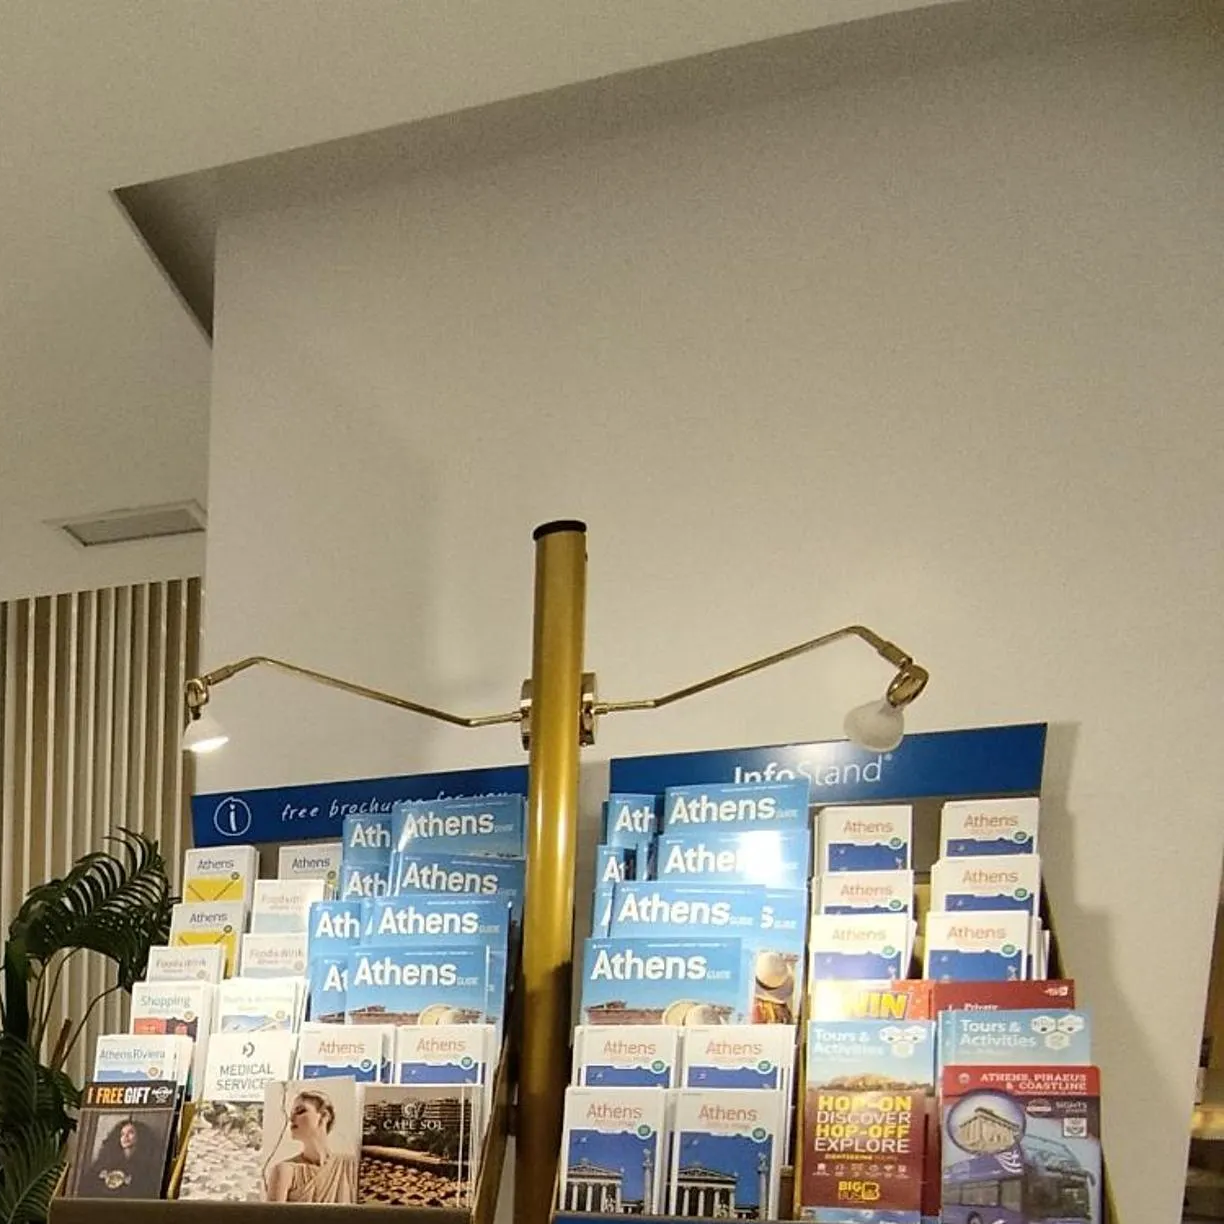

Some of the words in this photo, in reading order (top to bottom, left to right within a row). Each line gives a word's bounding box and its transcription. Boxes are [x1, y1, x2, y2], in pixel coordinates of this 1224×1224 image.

[281, 803, 319, 822] free
[329, 797, 424, 818] brochu
[669, 795, 776, 825] Athens
[403, 811, 494, 839] Athens
[843, 820, 893, 834] Athens
[964, 814, 1018, 829] Athens
[350, 823, 391, 848] Ath
[347, 871, 388, 897] Ath
[401, 862, 498, 895] Athens
[962, 870, 1018, 884] Athens
[841, 884, 893, 897] Athens
[618, 891, 730, 925] Athens
[315, 911, 359, 938] Ath
[378, 906, 479, 935] Athens
[832, 928, 887, 941] Athens
[947, 926, 1007, 940] Athens
[354, 956, 457, 986] Athens
[591, 949, 707, 980] Athens
[140, 996, 191, 1008] Shopping
[960, 1019, 1006, 1033] Tours
[1008, 1021, 1022, 1033] &
[814, 1029, 857, 1041] Tours
[960, 1034, 1037, 1048] Activities
[318, 1040, 365, 1054] Athens
[416, 1038, 465, 1052] Athens
[603, 1040, 657, 1054] Athens
[706, 1041, 763, 1055] Athens
[219, 1064, 274, 1076] MEDICAL
[96, 1087, 125, 1104] FREE
[124, 1087, 151, 1104] GIFT
[817, 1095, 912, 1111] HOP-ON
[587, 1103, 642, 1119] Athens
[698, 1104, 758, 1122] Athens
[816, 1111, 912, 1125] DISCOVER
[383, 1120, 417, 1130] CAPE
[420, 1120, 445, 1130] SOL
[815, 1124, 910, 1138] HOP-OFF
[814, 1138, 911, 1153] EXPLORE
[838, 1181, 862, 1192] BIG
